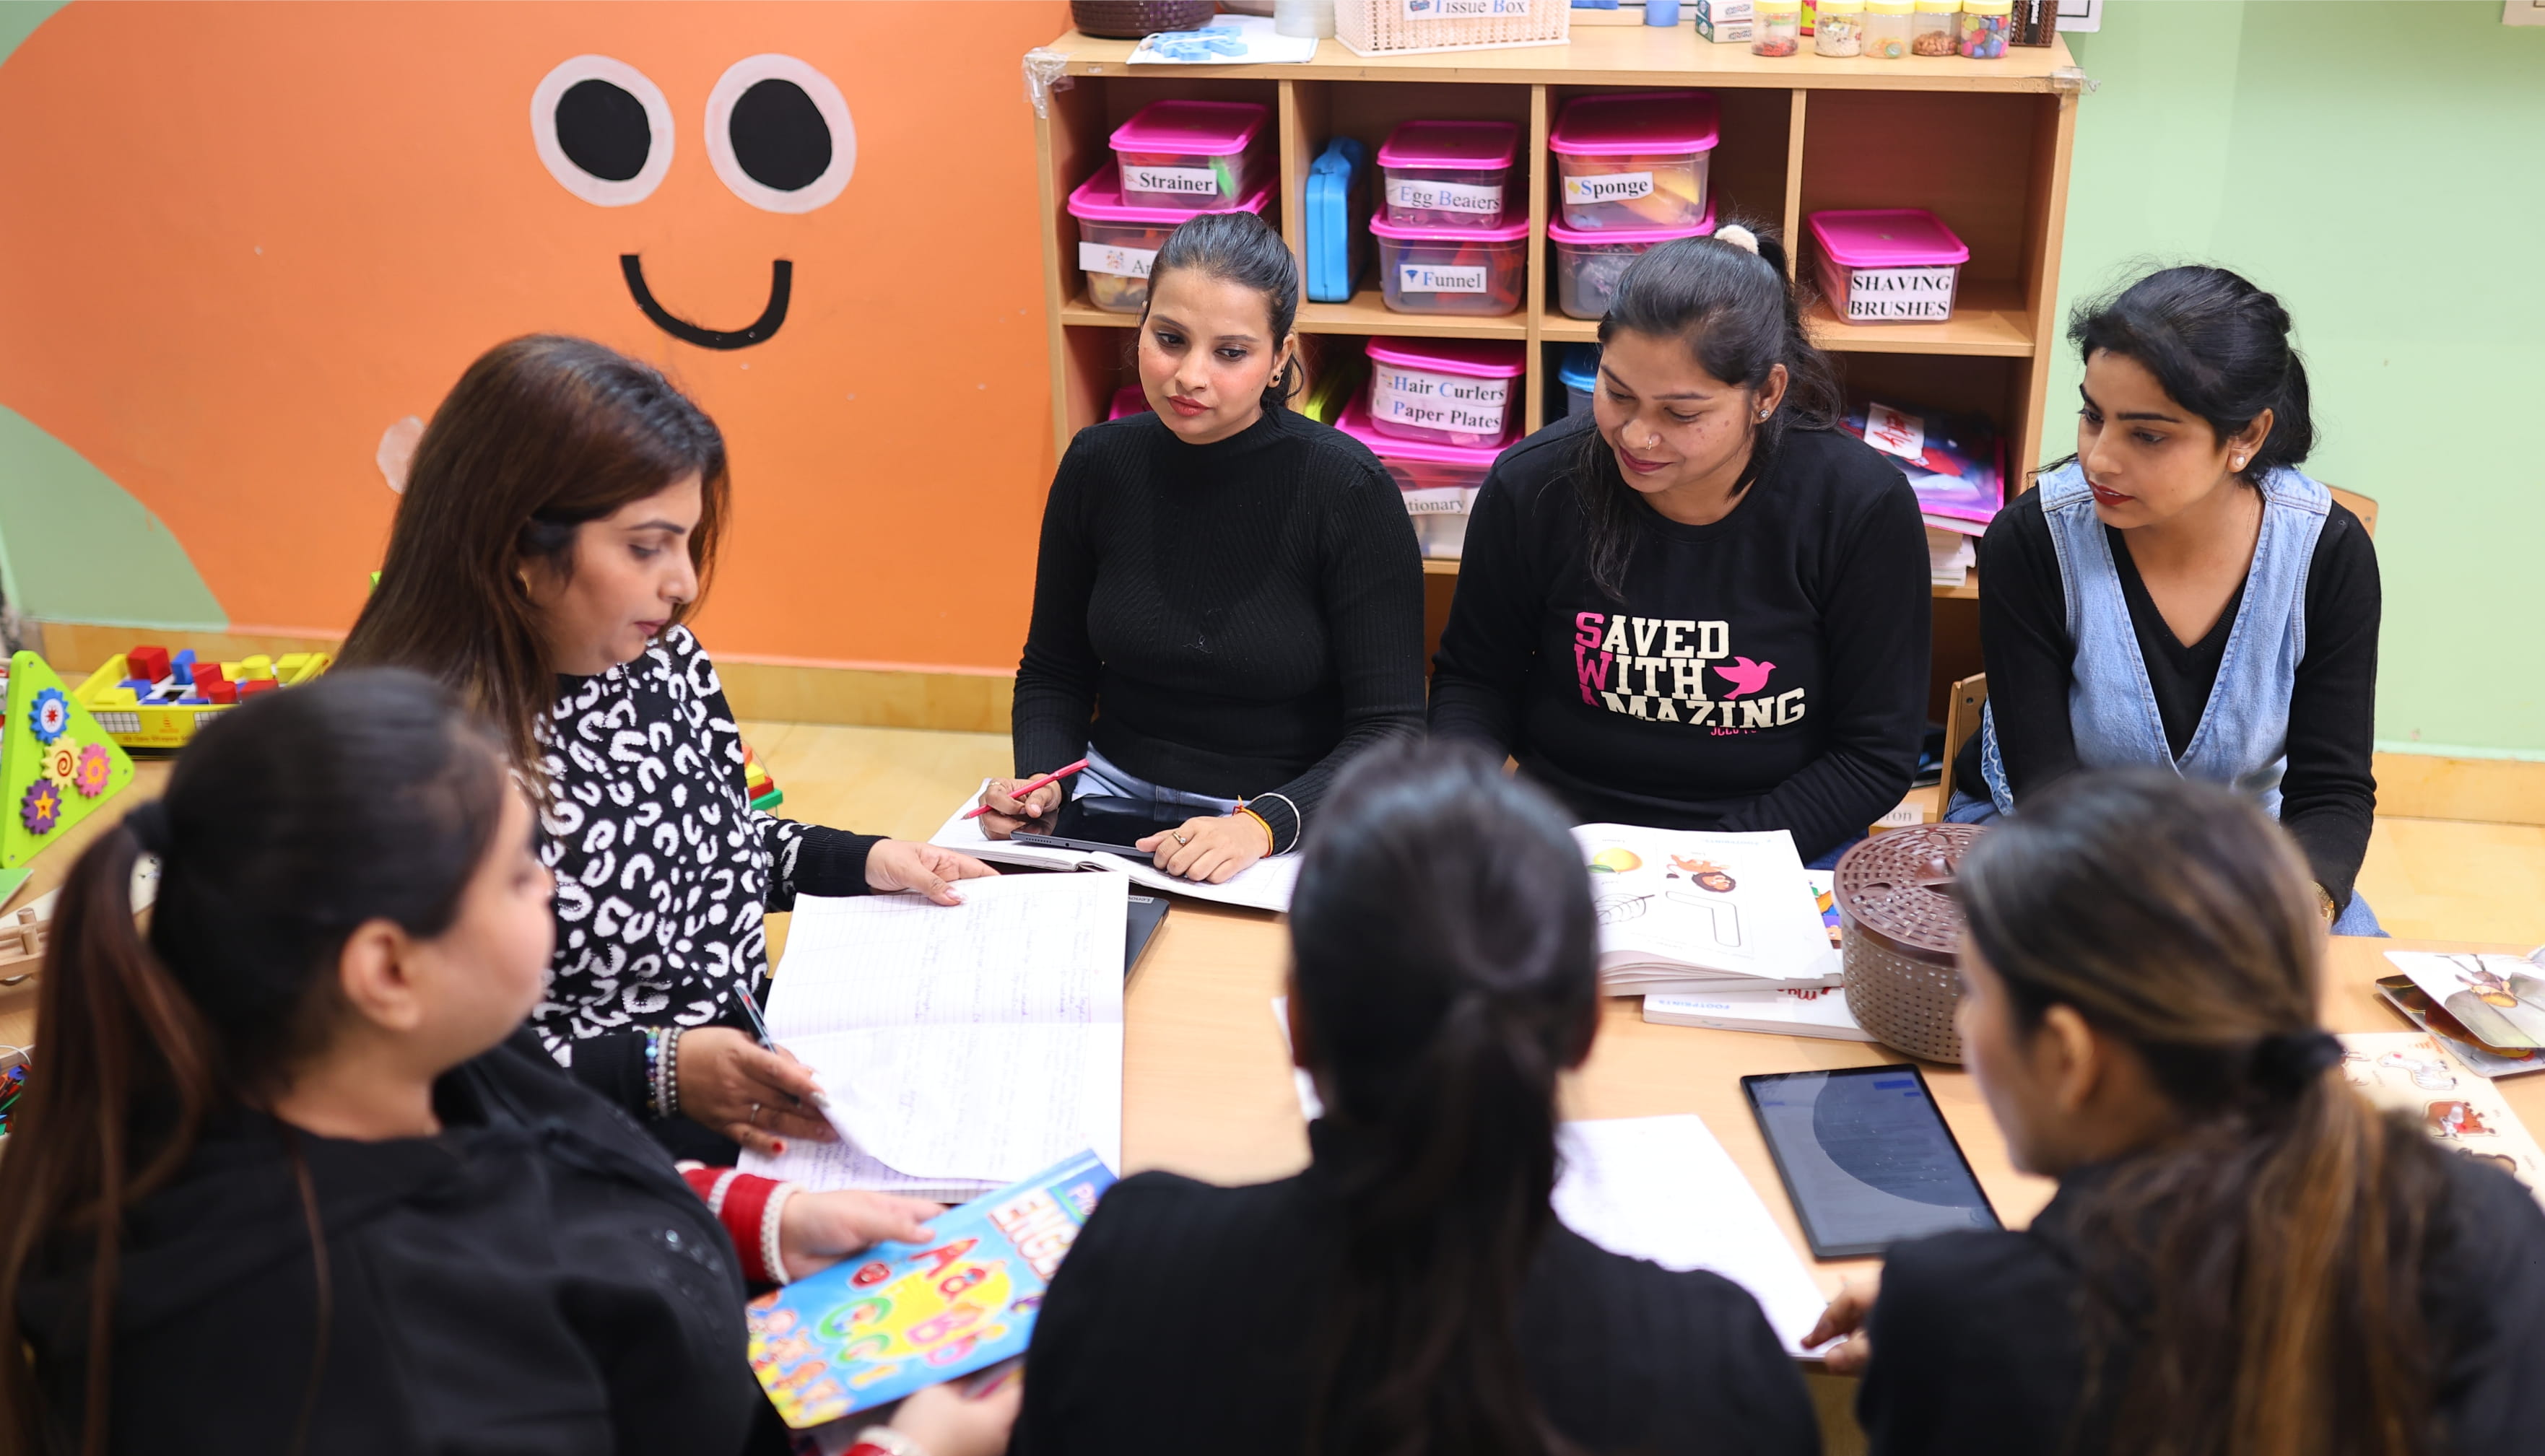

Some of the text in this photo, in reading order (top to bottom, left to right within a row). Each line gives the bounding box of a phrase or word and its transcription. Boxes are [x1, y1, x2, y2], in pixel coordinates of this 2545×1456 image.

[1434, 0, 1526, 14] Tissue Box
[1139, 172, 1214, 192] Strainer
[1580, 180, 1648, 199] Sponge
[1400, 186, 1433, 208] Egg
[1422, 271, 1482, 289] Funnel
[1852, 275, 1951, 292] SHAVING
[1850, 300, 1948, 316] BRUSHES
[1393, 375, 1505, 401] Hair Curlers
[1393, 400, 1501, 429] Paper Plates
[1408, 499, 1466, 513] tionary
[1575, 611, 1729, 660] SAVED
[1573, 643, 1708, 701] WITH
[1884, 811, 1913, 821] ron
[1658, 999, 1731, 1010] FOOTPRINTS
[986, 1185, 1082, 1283] ENGL
